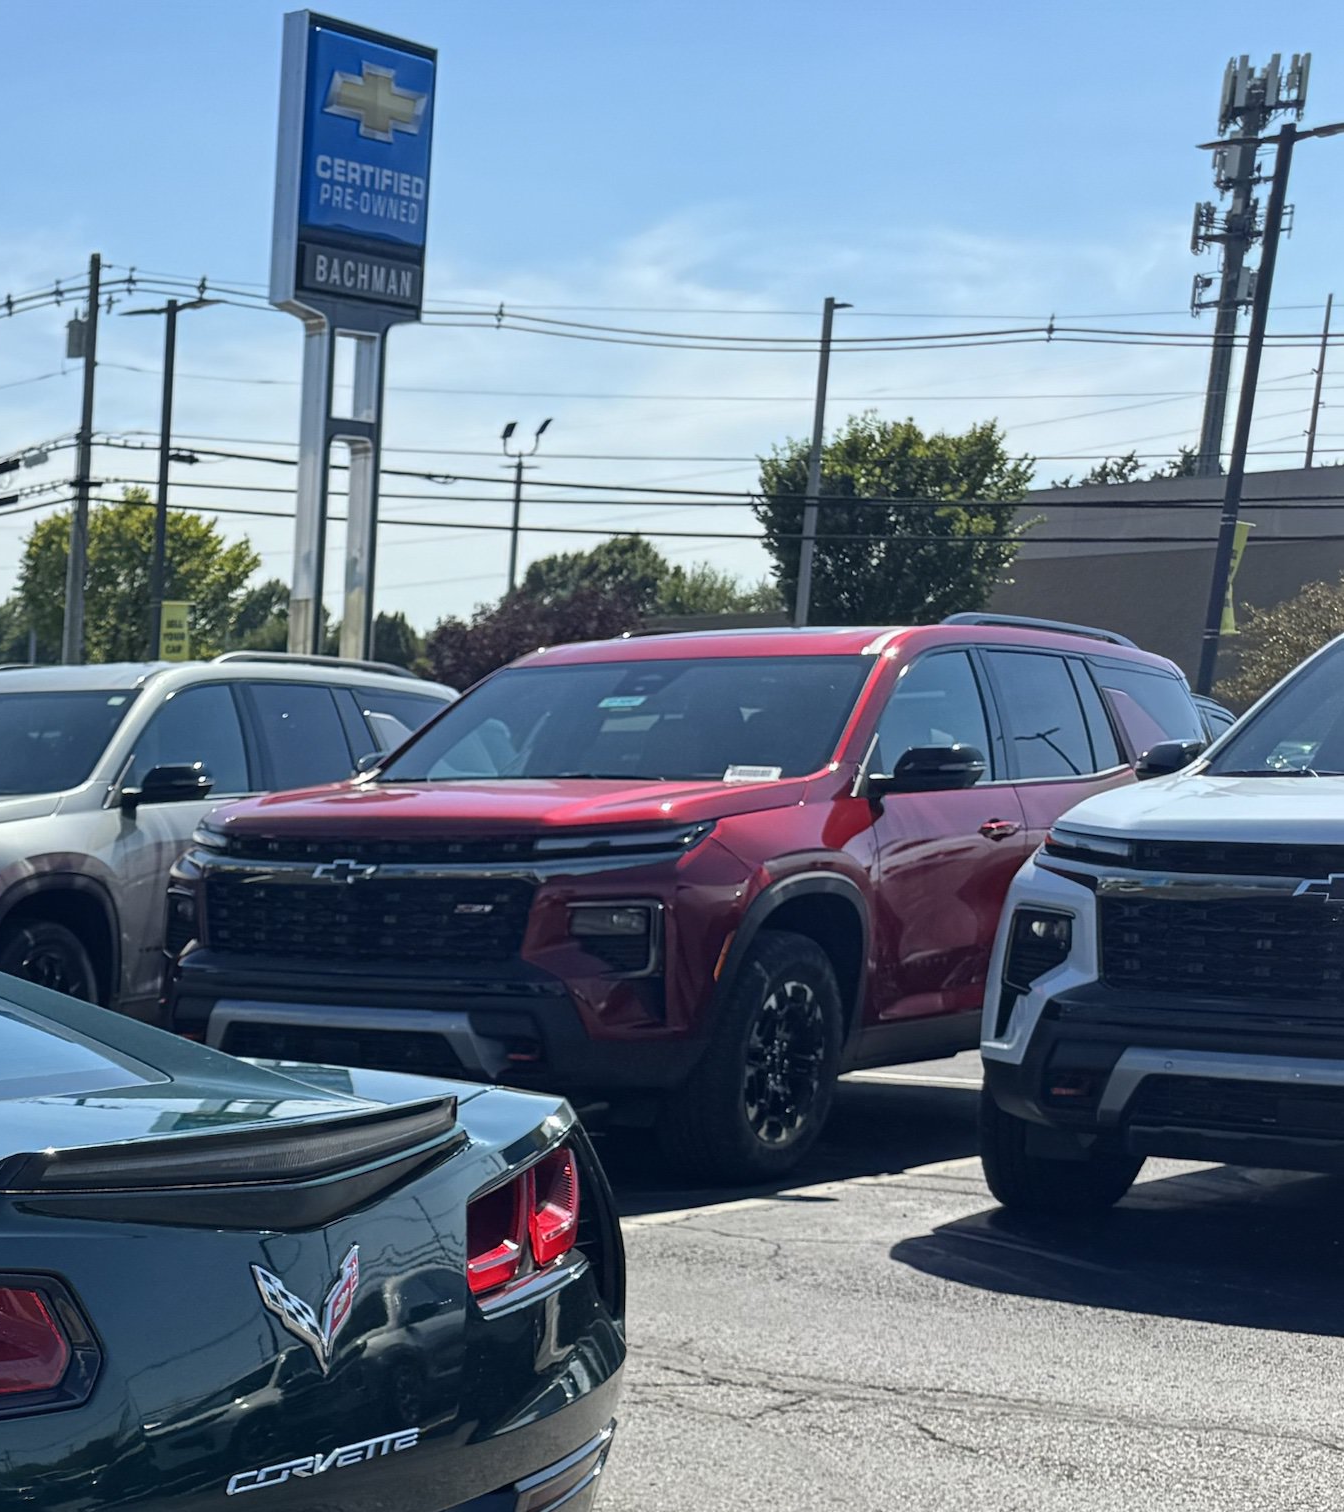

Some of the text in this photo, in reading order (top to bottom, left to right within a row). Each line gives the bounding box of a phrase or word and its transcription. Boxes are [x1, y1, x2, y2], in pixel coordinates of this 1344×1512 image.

[316, 154, 426, 200] CERTIFIED
[319, 183, 419, 224] PRE-OWNED
[315, 254, 413, 298] BACHMAN
[226, 1427, 421, 1496] CORVETTE
